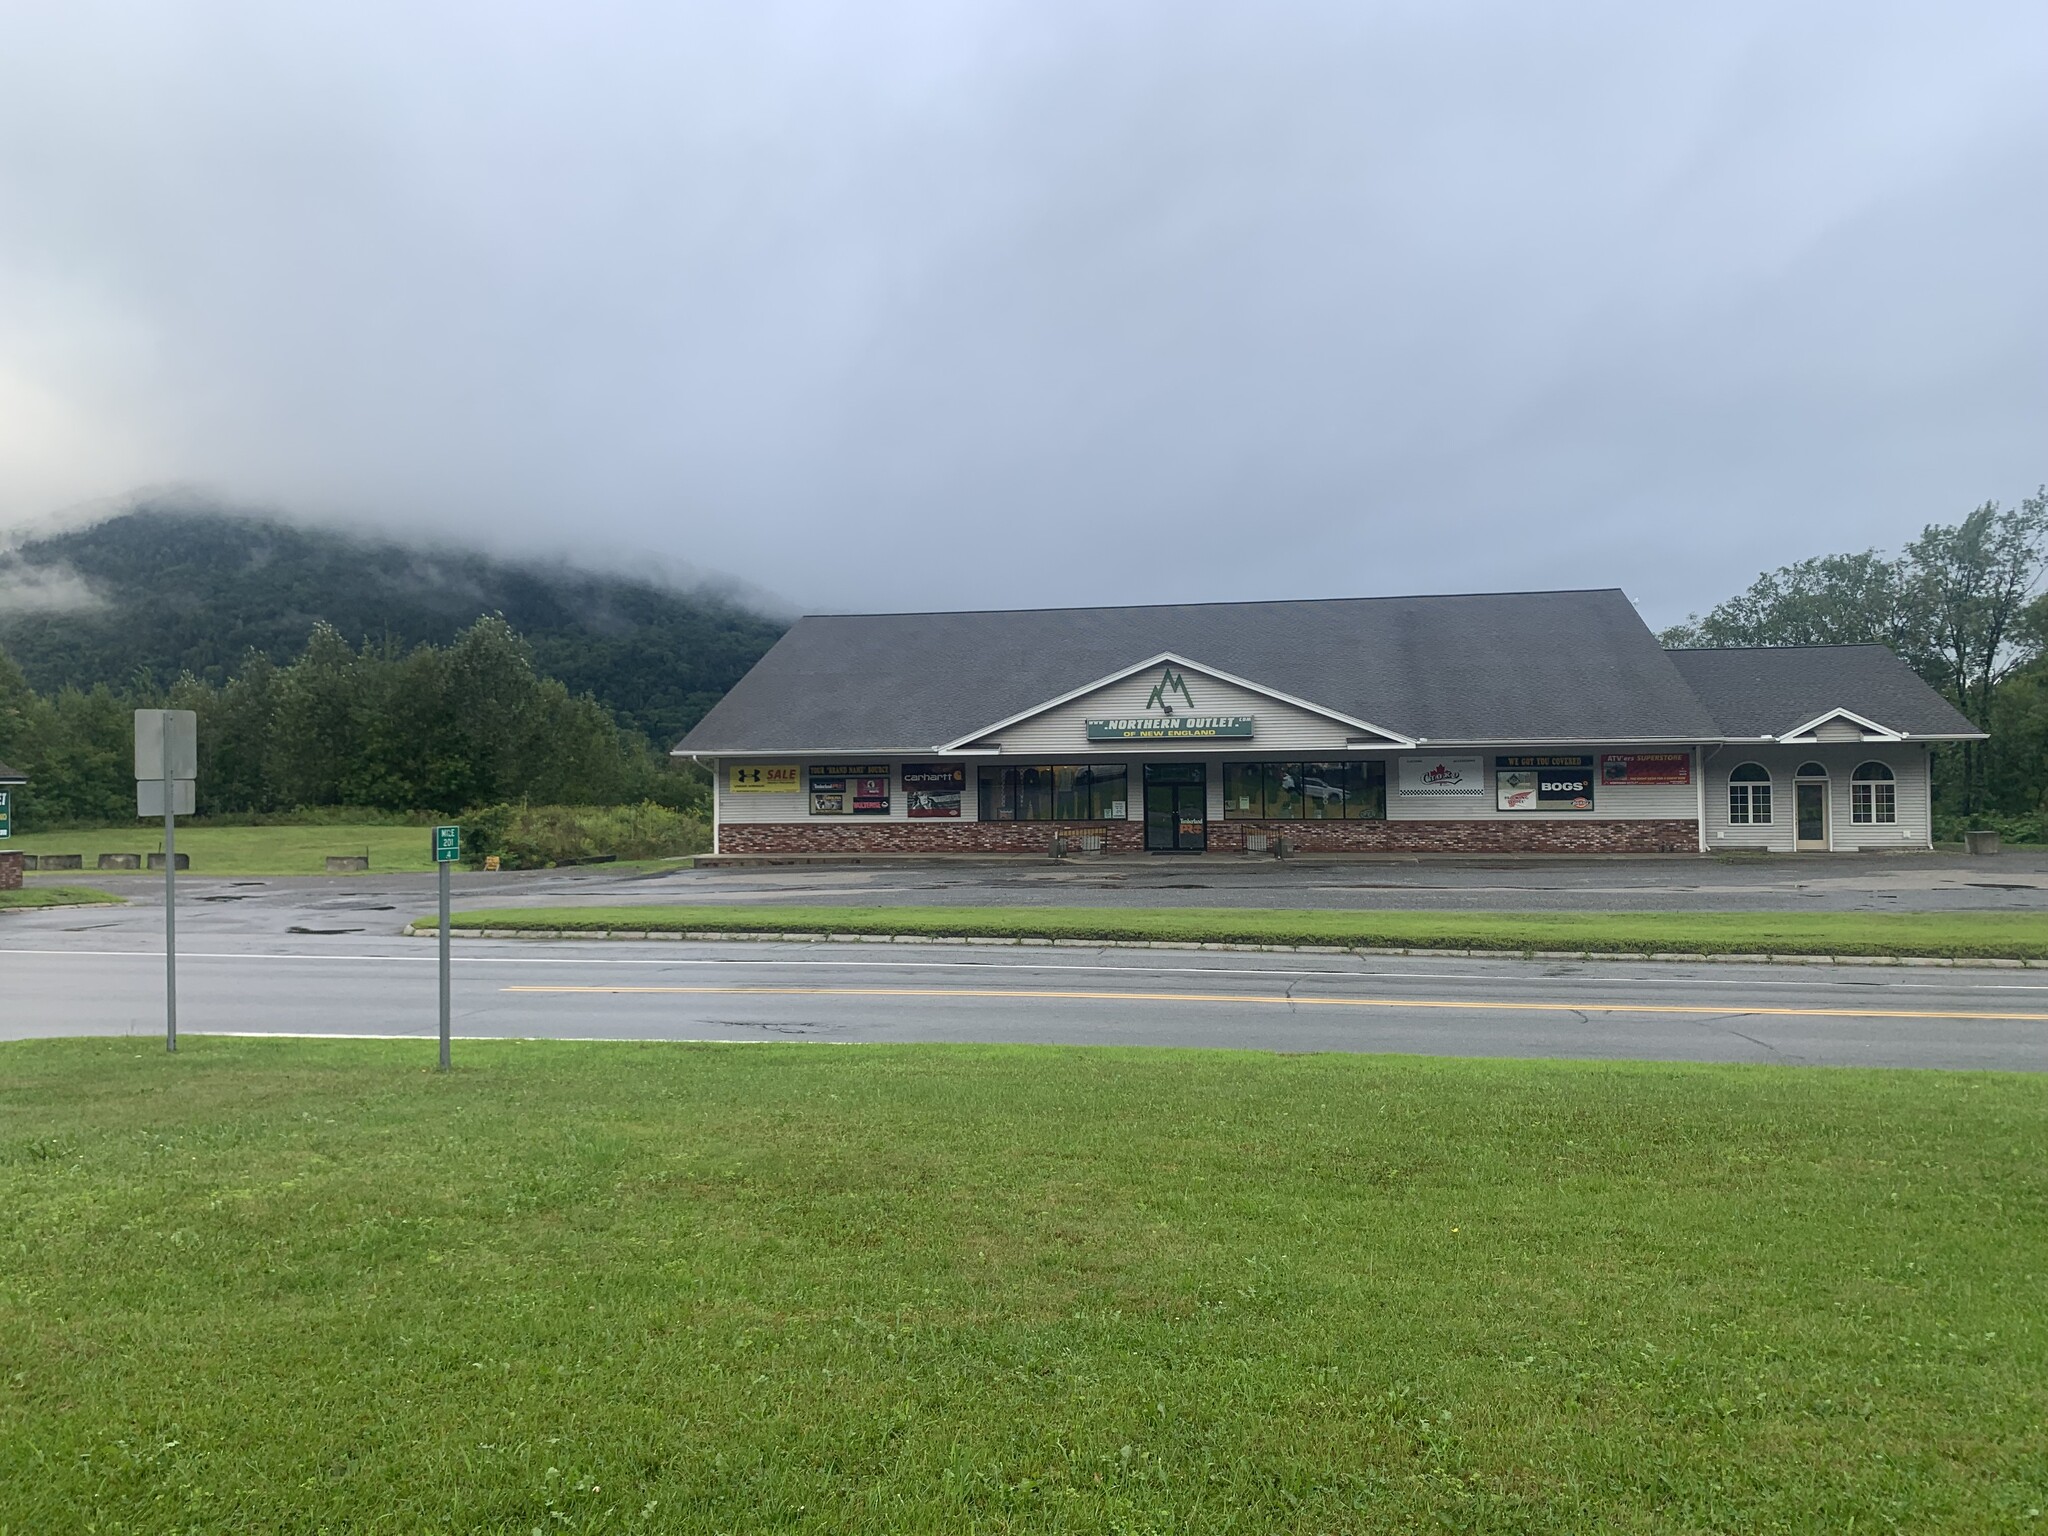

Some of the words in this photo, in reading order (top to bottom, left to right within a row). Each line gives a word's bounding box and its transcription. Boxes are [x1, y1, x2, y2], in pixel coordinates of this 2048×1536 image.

[1508, 757, 1519, 766] WE
[1521, 757, 1534, 766] GOT
[1536, 757, 1550, 766] YOU
[1551, 757, 1582, 766] COVERED
[767, 769, 797, 780] SALE
[904, 773, 953, 781] carhartt
[1541, 782, 1584, 791] BOGS
